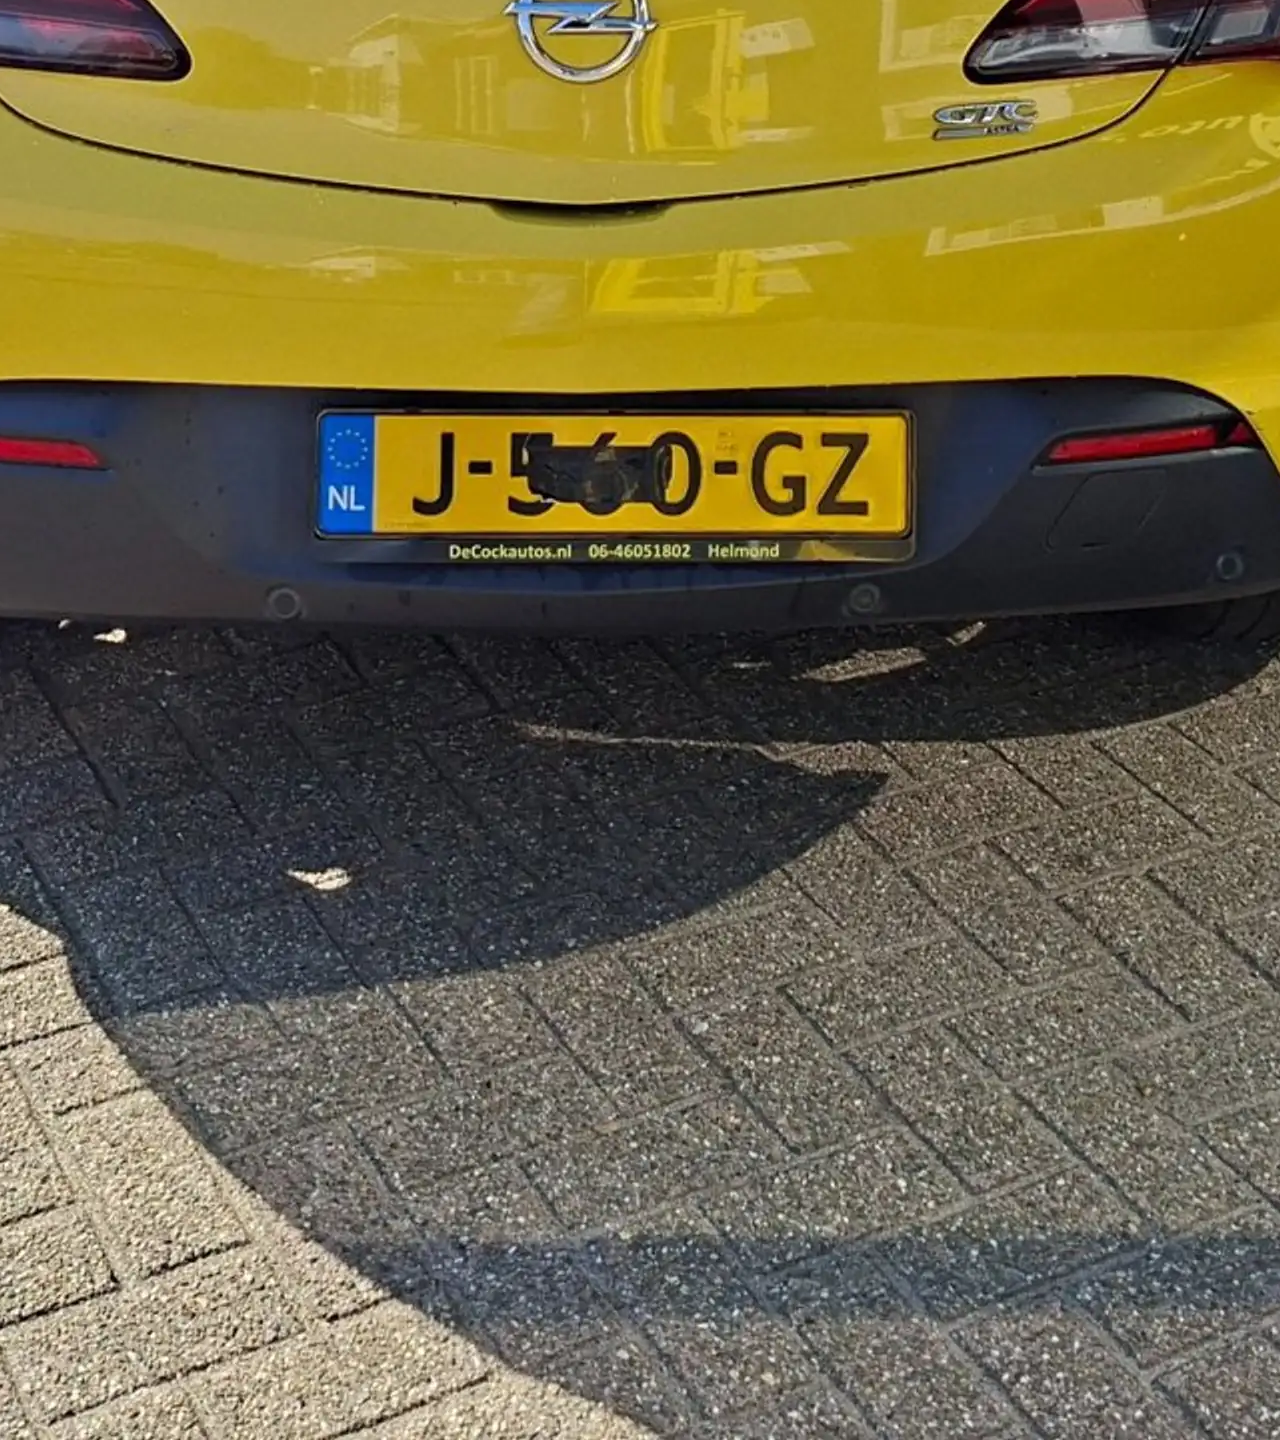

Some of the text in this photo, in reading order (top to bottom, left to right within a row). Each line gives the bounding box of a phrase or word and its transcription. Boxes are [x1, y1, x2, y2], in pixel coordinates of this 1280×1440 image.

[327, 484, 365, 512] NL
[448, 543, 780, 560] DeCockautos.nl 06-46051802 Helmond
